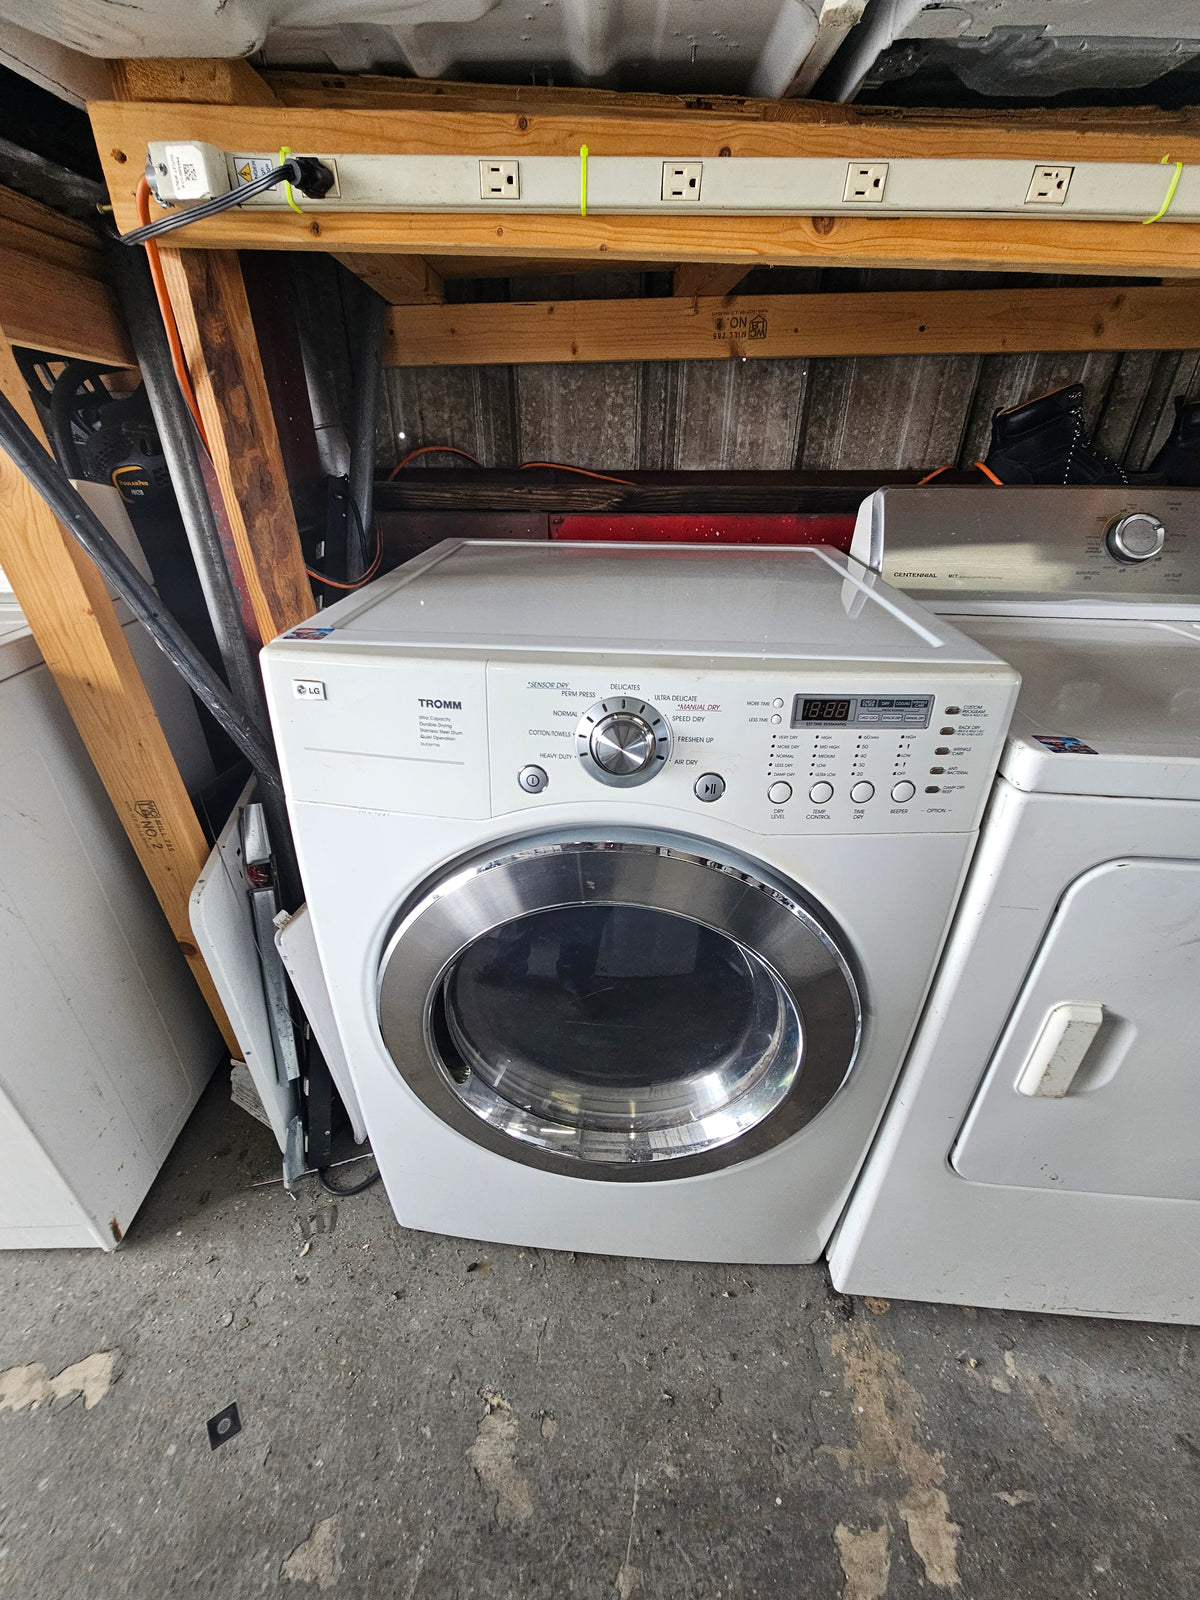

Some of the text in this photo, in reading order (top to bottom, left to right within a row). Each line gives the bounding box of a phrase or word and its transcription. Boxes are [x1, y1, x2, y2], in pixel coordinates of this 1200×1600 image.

[308, 687, 320, 695] LG
[610, 683, 641, 691] DELICATES
[561, 690, 596, 699] PERM PRESS
[418, 698, 462, 710] TROMM
[552, 710, 578, 718] NORMAL
[672, 715, 691, 723] SPEED
[539, 752, 558, 760] HEAVY
[674, 758, 684, 766] AIR
